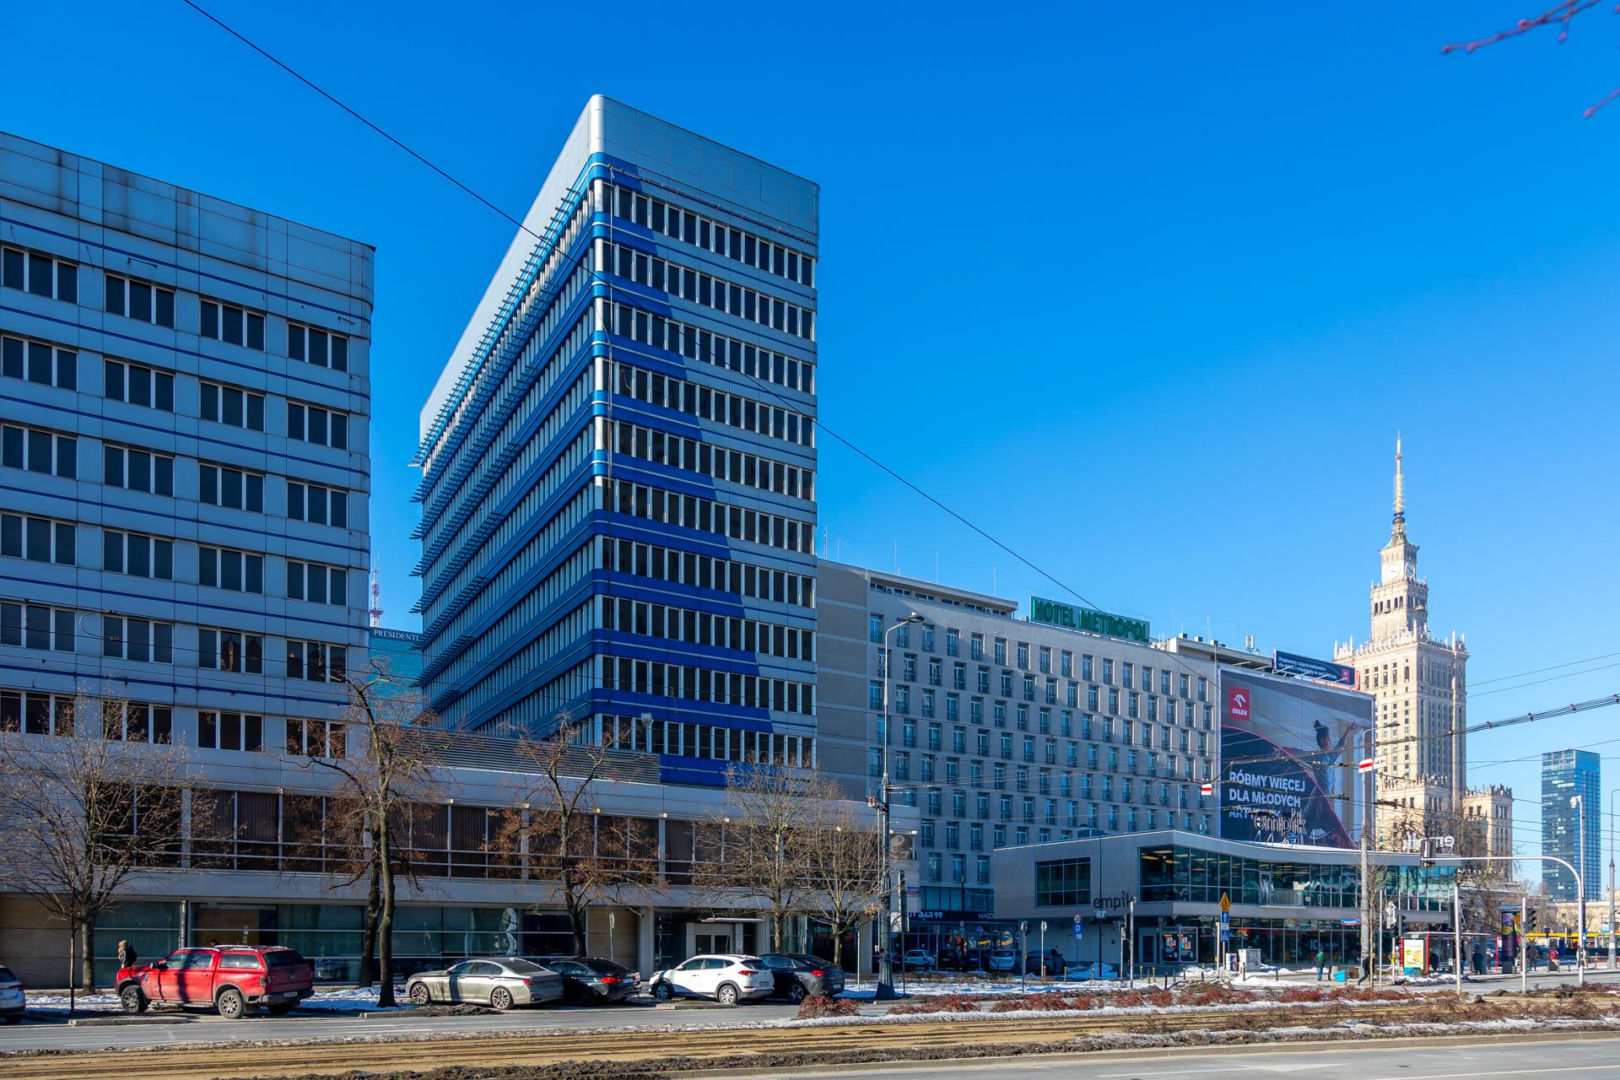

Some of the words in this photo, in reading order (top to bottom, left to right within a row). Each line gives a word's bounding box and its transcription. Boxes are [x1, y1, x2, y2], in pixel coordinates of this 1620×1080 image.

[1032, 599, 1076, 627] HOTEL
[1079, 610, 1149, 642] METROPOL
[1229, 769, 1268, 787] RÓBMY
[1269, 777, 1306, 793] WIĘCEJ
[1229, 788, 1250, 802] DLA
[1251, 791, 1301, 808] MŁODYCH
